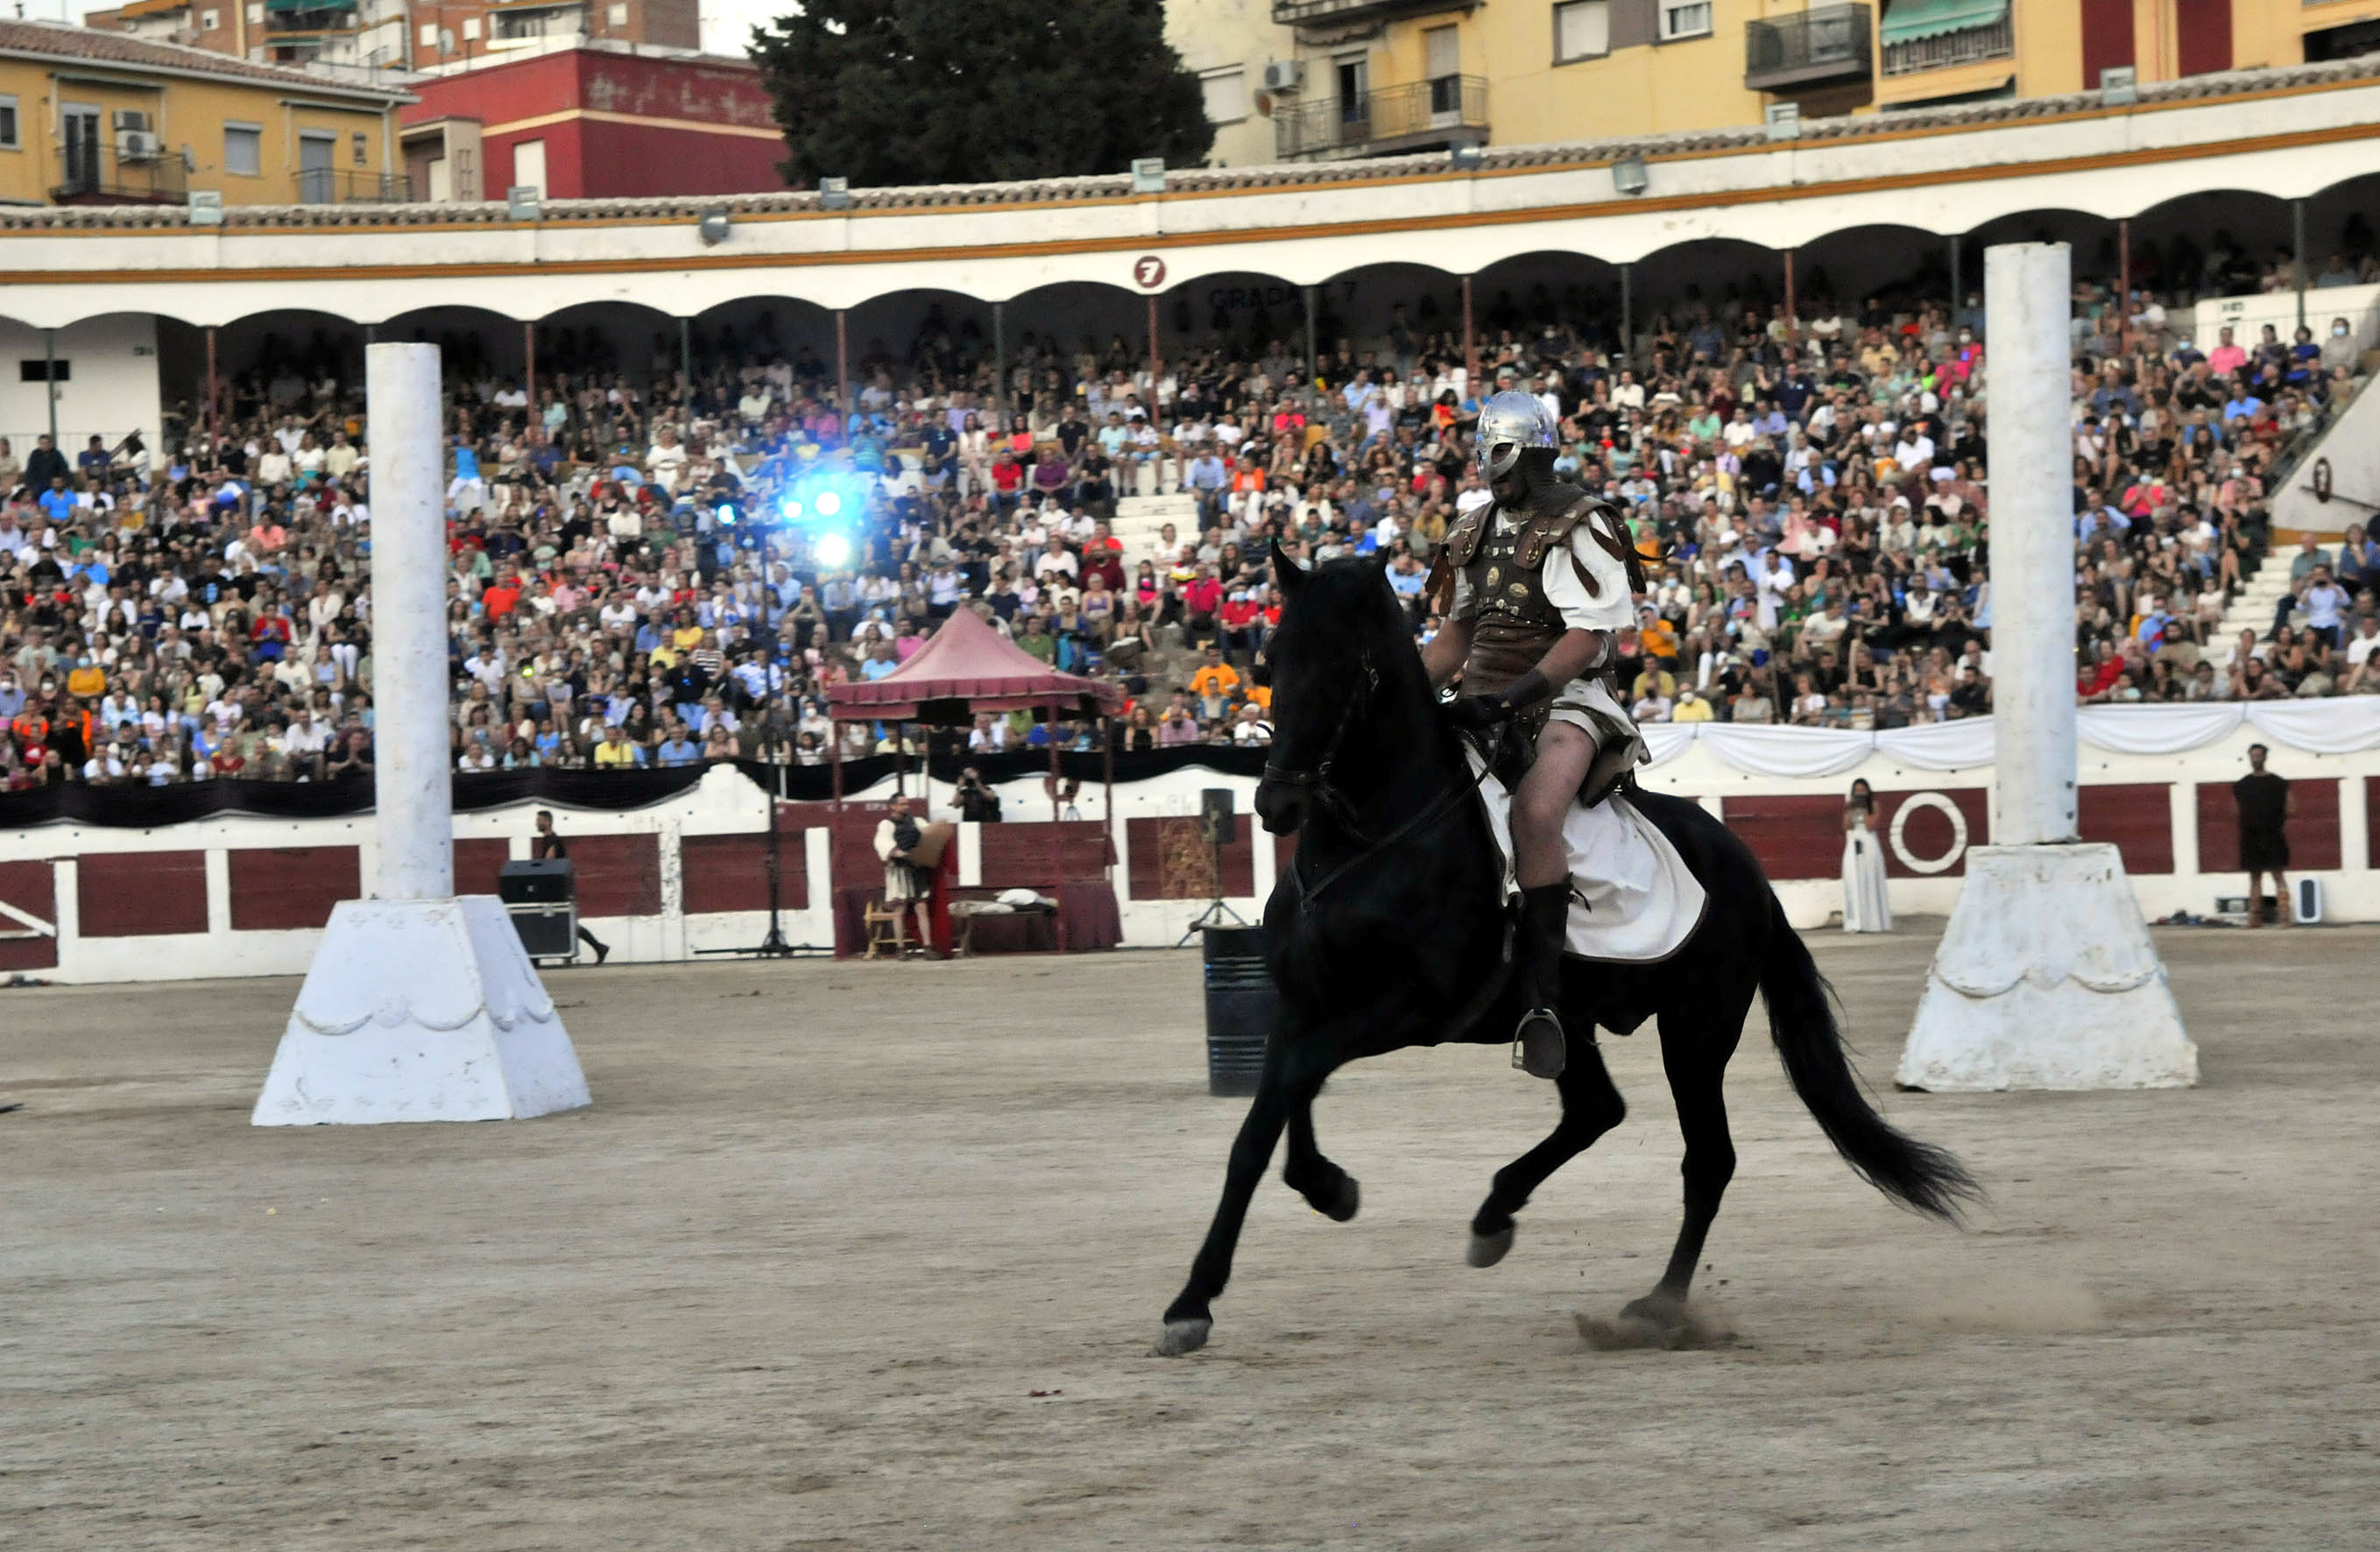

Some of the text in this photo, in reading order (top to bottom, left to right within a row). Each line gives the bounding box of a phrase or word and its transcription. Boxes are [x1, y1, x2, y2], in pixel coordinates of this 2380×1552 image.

[1141, 261, 1161, 284] 7
[1210, 286, 1303, 308] GRADA
[1343, 280, 1358, 302] 7
